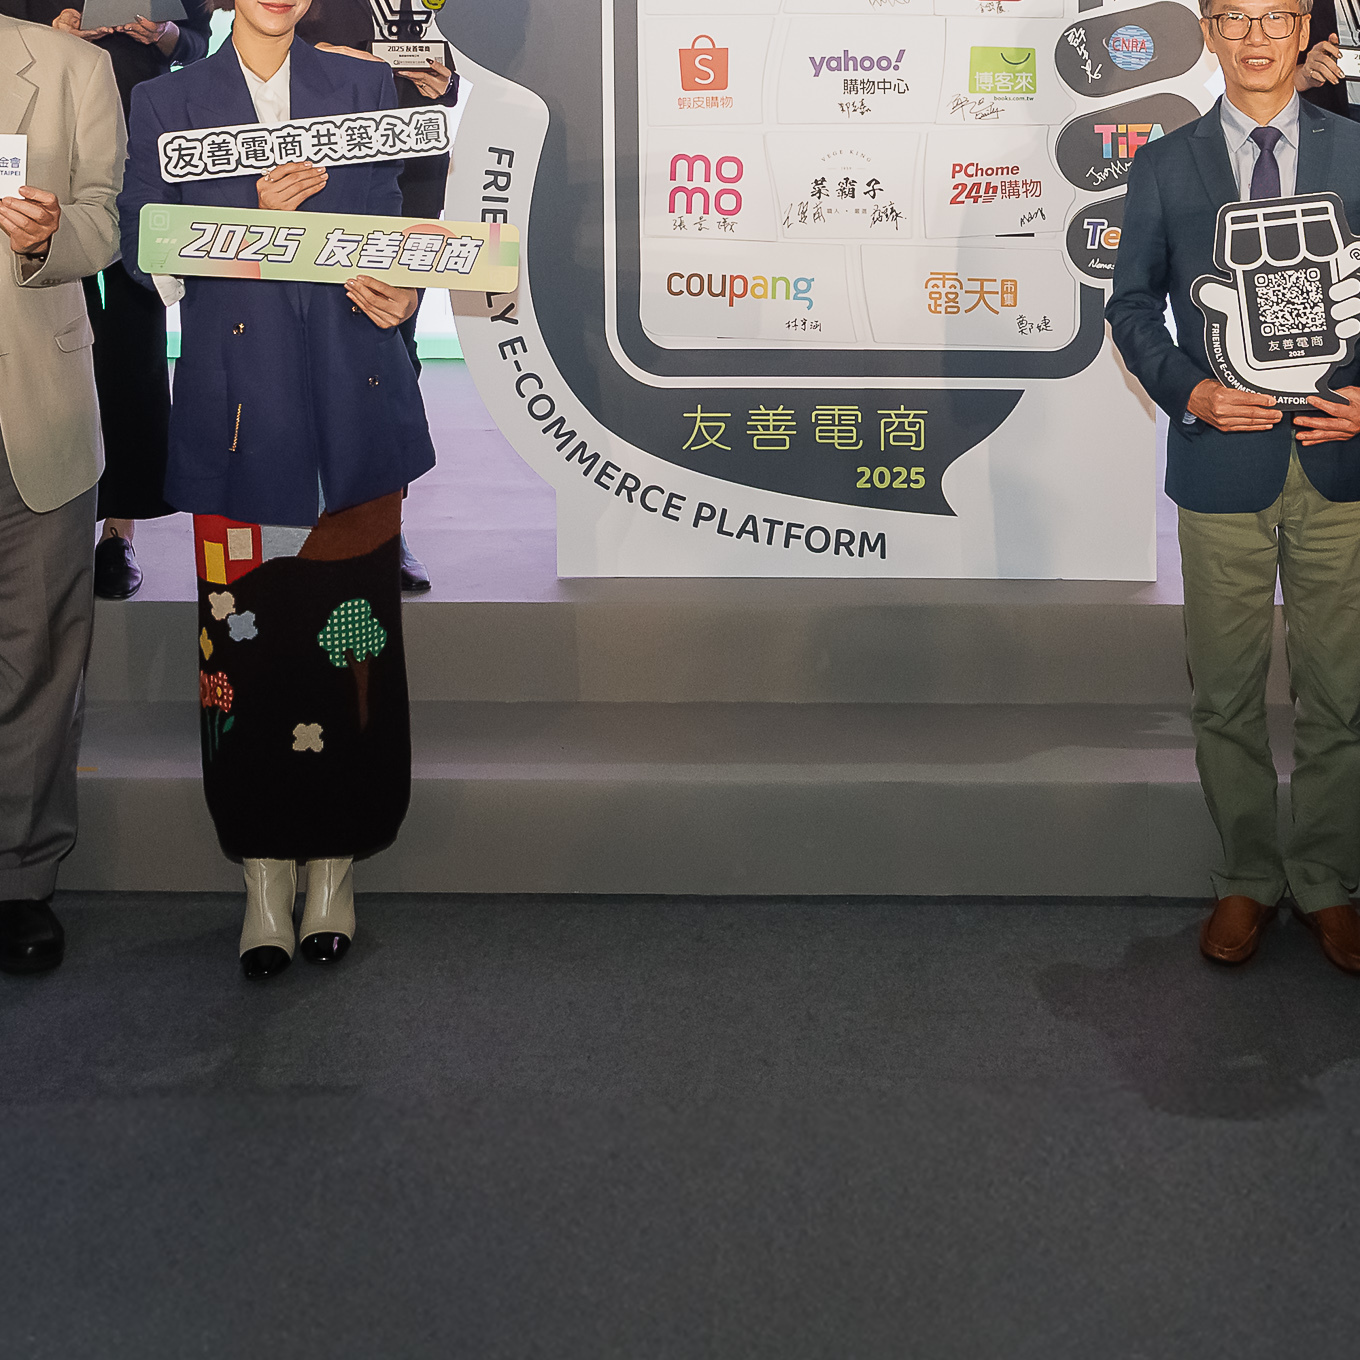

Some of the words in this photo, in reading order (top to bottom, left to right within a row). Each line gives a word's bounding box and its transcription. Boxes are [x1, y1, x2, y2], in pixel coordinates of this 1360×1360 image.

[1112, 37, 1148, 53] CNRA
[808, 49, 906, 78] yahoo!
[843, 78, 910, 96] 購物中心
[974, 71, 1035, 93] 博客來
[677, 96, 734, 110] 蝦皮購物
[170, 117, 441, 170] 友善電商共築永續
[821, 149, 844, 162] VEGE
[849, 149, 872, 163] KING
[951, 162, 1020, 179] PChome
[179, 221, 306, 261] 2025
[315, 228, 484, 275] 友善電商
[666, 271, 815, 311] coupang
[924, 271, 1000, 316] 露天
[1211, 322, 1226, 365] FRIENDLY
[1267, 335, 1324, 352] 友善電商
[1288, 349, 1306, 358] 2025
[681, 403, 930, 453] 友善電商
[498, 333, 687, 523] E-COMMERCE
[691, 499, 888, 561] PLATFORM
[855, 466, 926, 491] 2025
